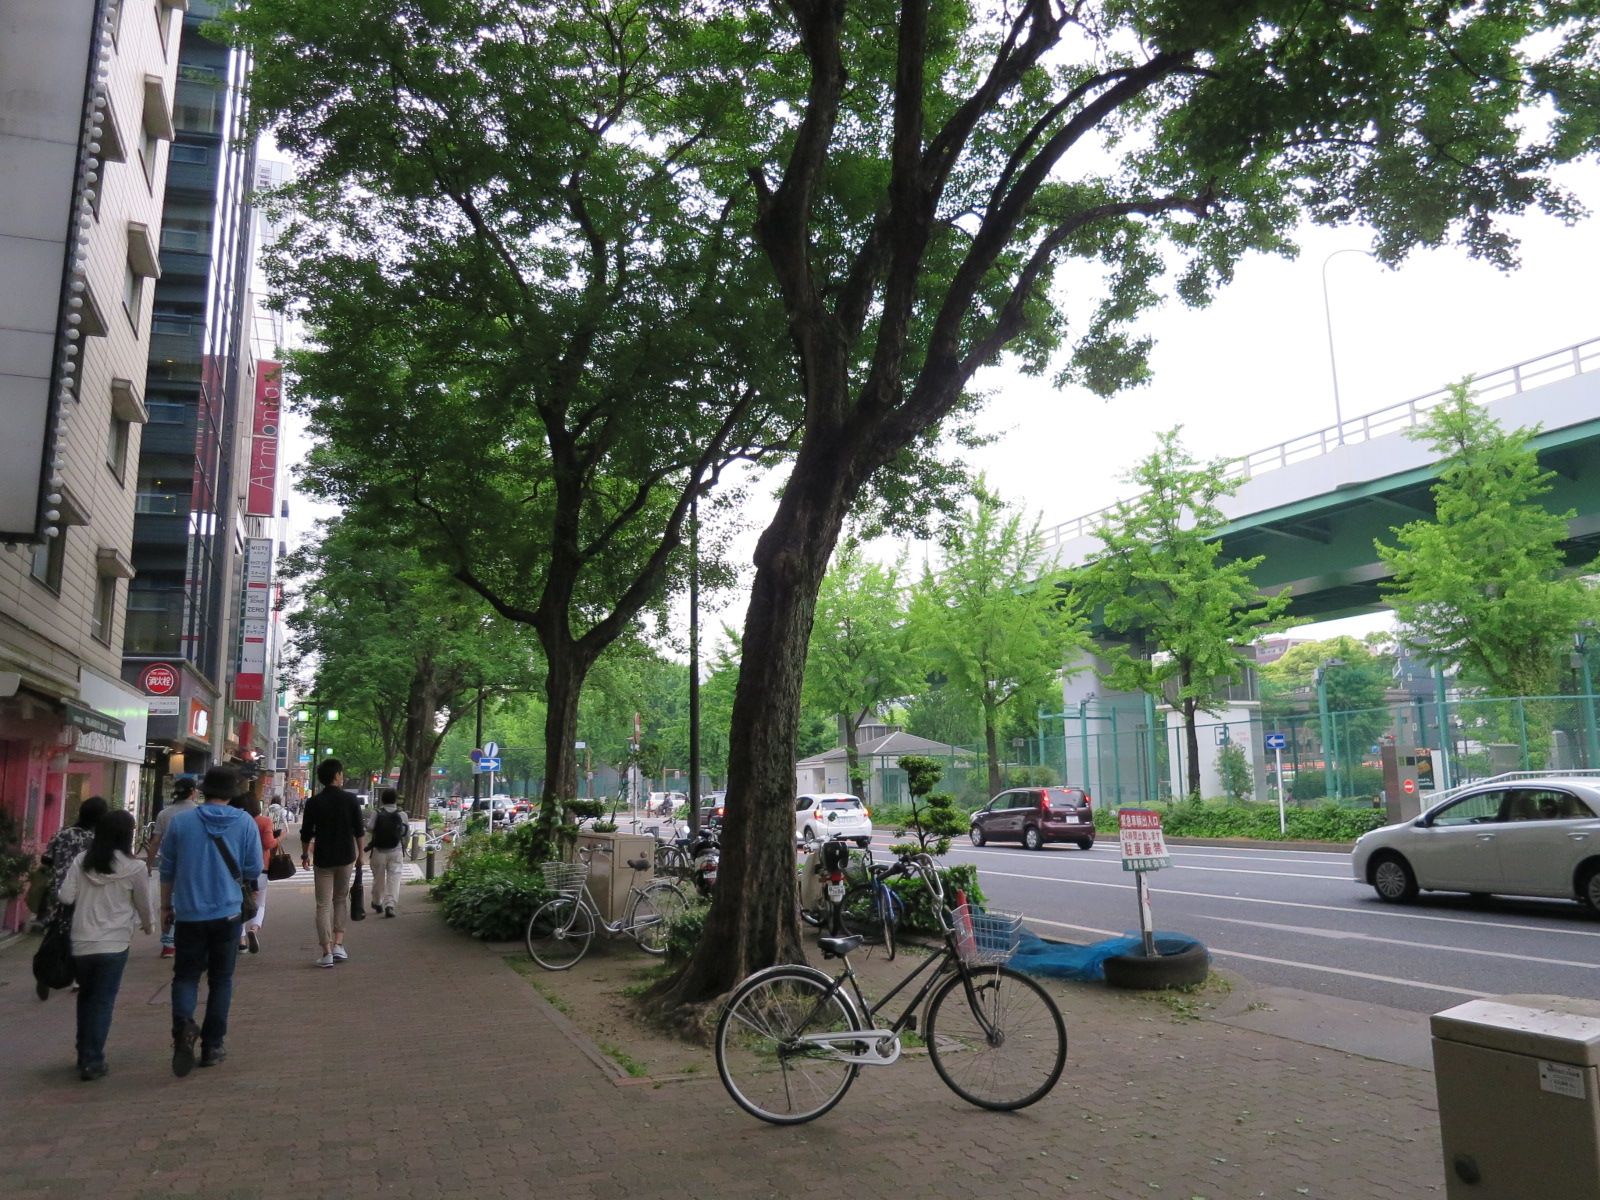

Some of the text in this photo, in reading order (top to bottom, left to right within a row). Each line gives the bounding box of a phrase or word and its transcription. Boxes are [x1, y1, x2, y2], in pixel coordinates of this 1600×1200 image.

[148, 676, 172, 686] 消火栓
[1124, 842, 1163, 856] 駐車厳禁
